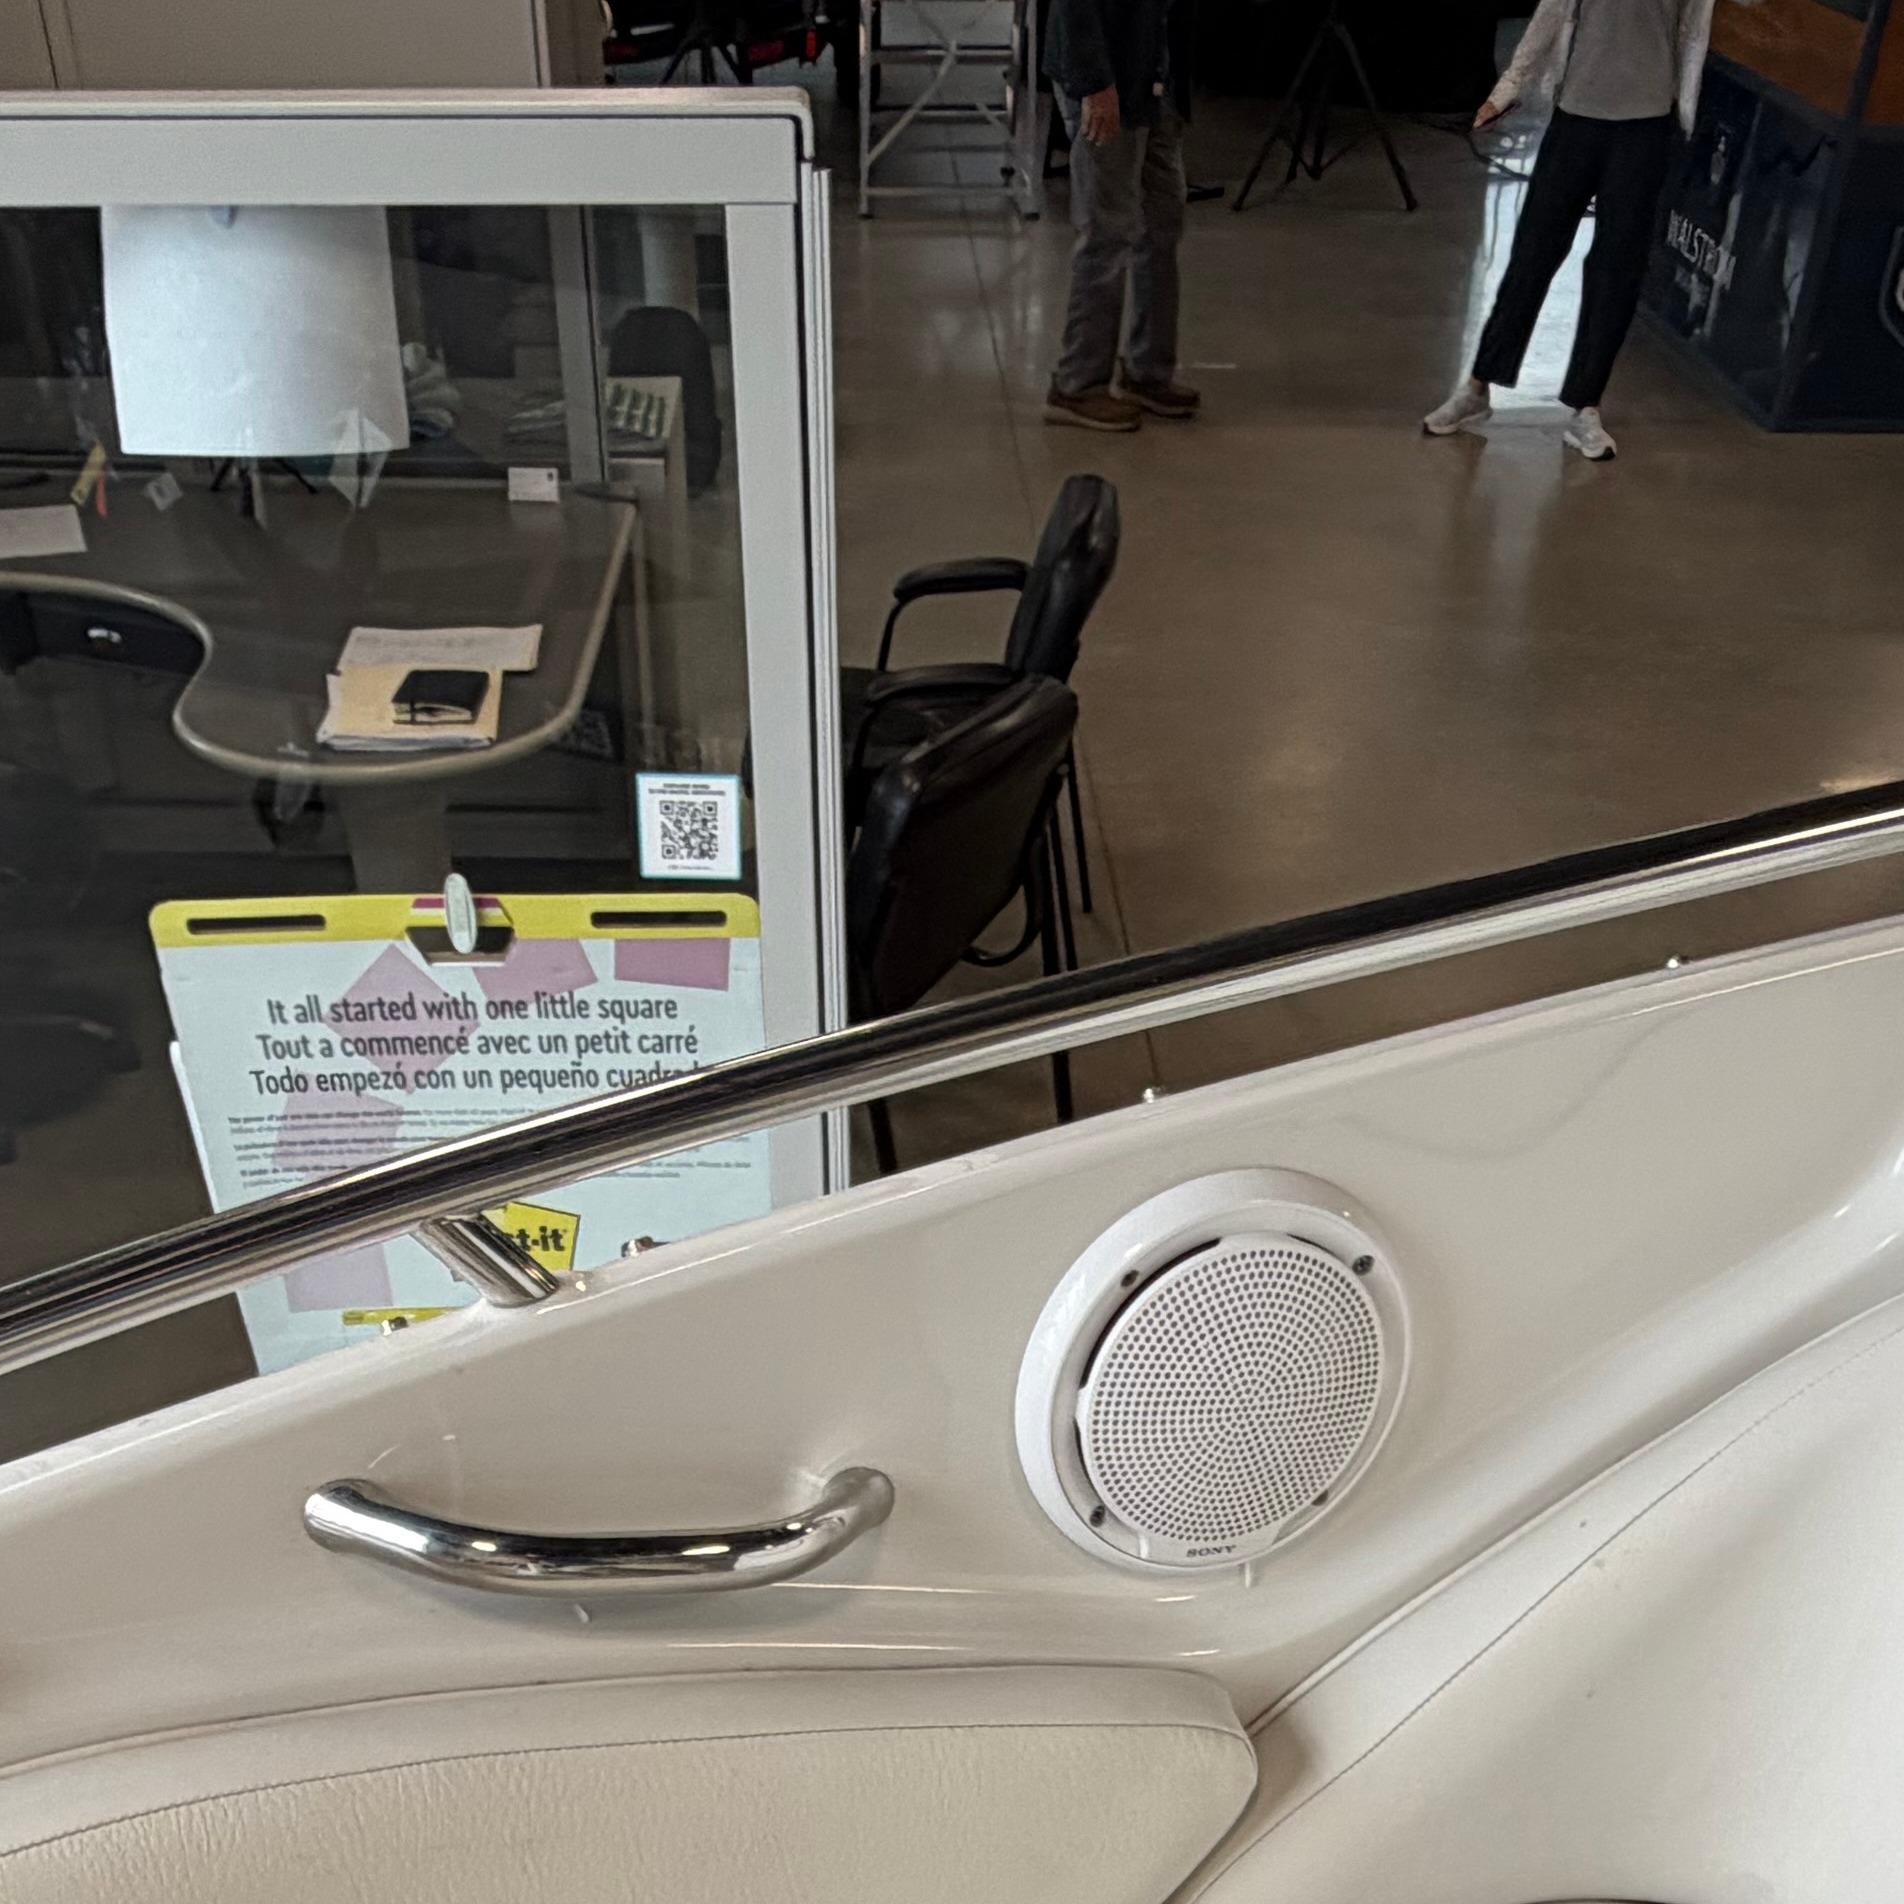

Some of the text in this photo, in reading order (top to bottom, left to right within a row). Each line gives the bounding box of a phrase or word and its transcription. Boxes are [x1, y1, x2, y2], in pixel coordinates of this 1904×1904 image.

[267, 991, 678, 1025] It all started with one little square
[255, 1024, 699, 1060] Tout a commencé avec un petit carré
[249, 1061, 699, 1098] Todo empezó con un pequeño cuadr
[1186, 1544, 1237, 1558] SONY
